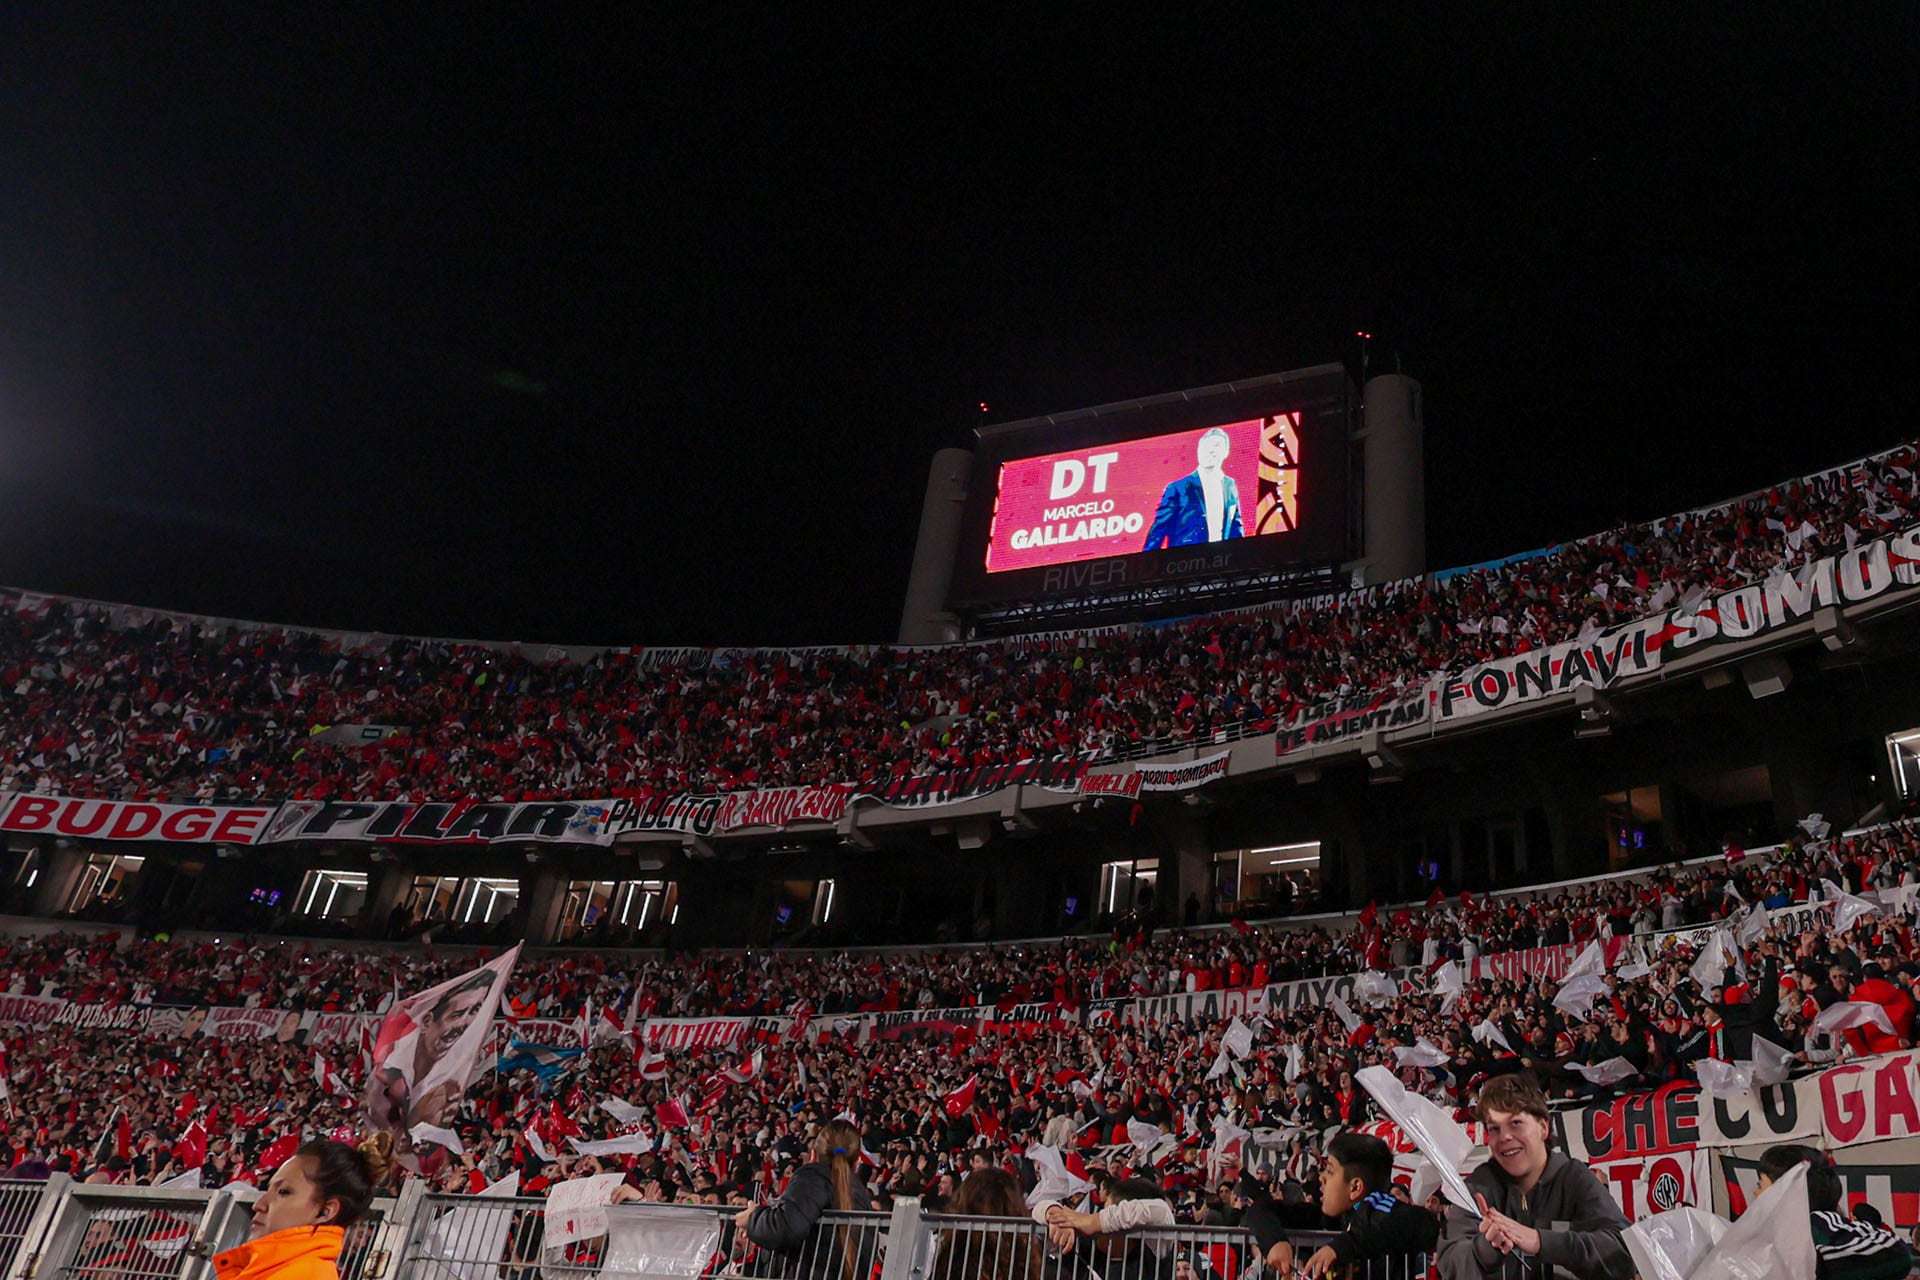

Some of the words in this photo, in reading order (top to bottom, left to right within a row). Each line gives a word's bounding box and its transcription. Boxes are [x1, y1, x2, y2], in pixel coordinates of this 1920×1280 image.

[1049, 451, 1119, 500] DT
[1011, 512, 1143, 550] GALLARDO
[1043, 499, 1115, 522] MARCELO
[1043, 559, 1128, 591] RIVER
[1672, 525, 1920, 650] SOMOS
[1442, 628, 1646, 717] FONAVI
[1276, 726, 1307, 751] TE
[1312, 699, 1425, 743] ALIENTAN
[2, 795, 268, 844] BUDGE
[301, 803, 580, 841] PILAR
[603, 793, 722, 834] PABLITO
[1140, 992, 1220, 1026] VILLA
[1225, 986, 1263, 1018] DE
[1267, 975, 1356, 1015] MAYO
[1819, 1056, 1920, 1143] GA
